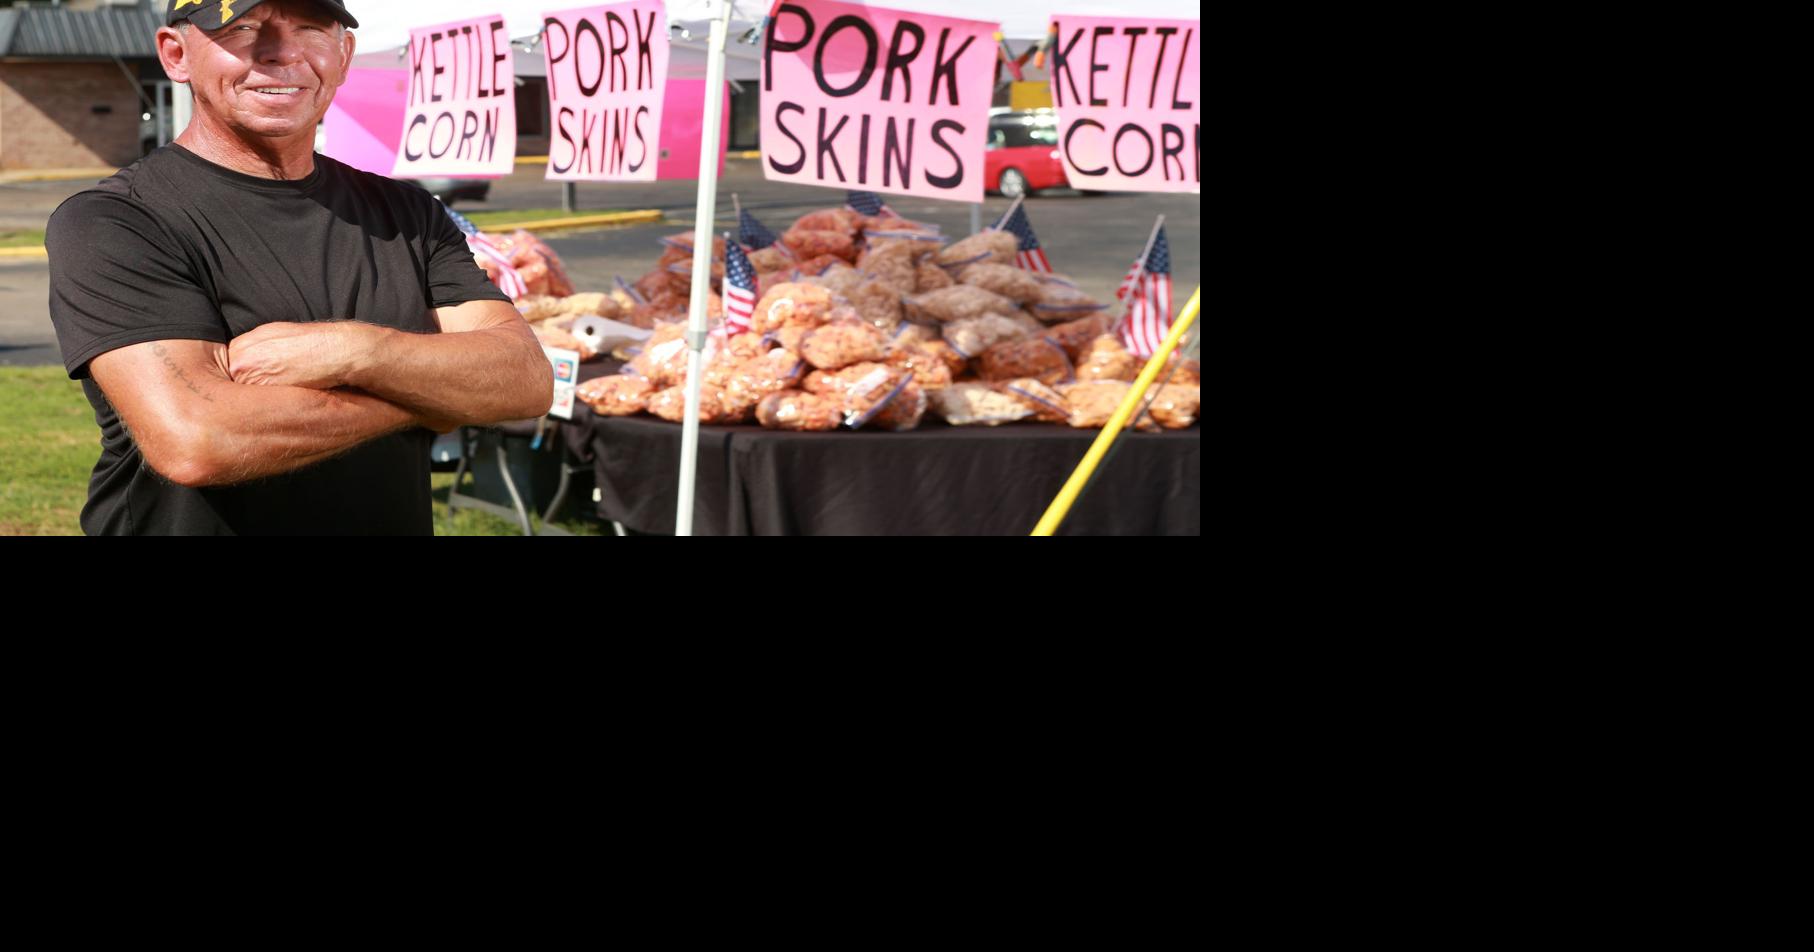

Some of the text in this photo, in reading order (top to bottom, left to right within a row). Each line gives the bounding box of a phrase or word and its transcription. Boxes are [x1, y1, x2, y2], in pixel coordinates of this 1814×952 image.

[409, 20, 506, 107] KETTLE
[543, 8, 656, 100] PORK
[762, 4, 977, 106] PORK
[405, 106, 499, 163] CORN
[552, 105, 649, 174] SKINS
[768, 101, 966, 190] SKINS
[1064, 118, 1200, 182] COR
